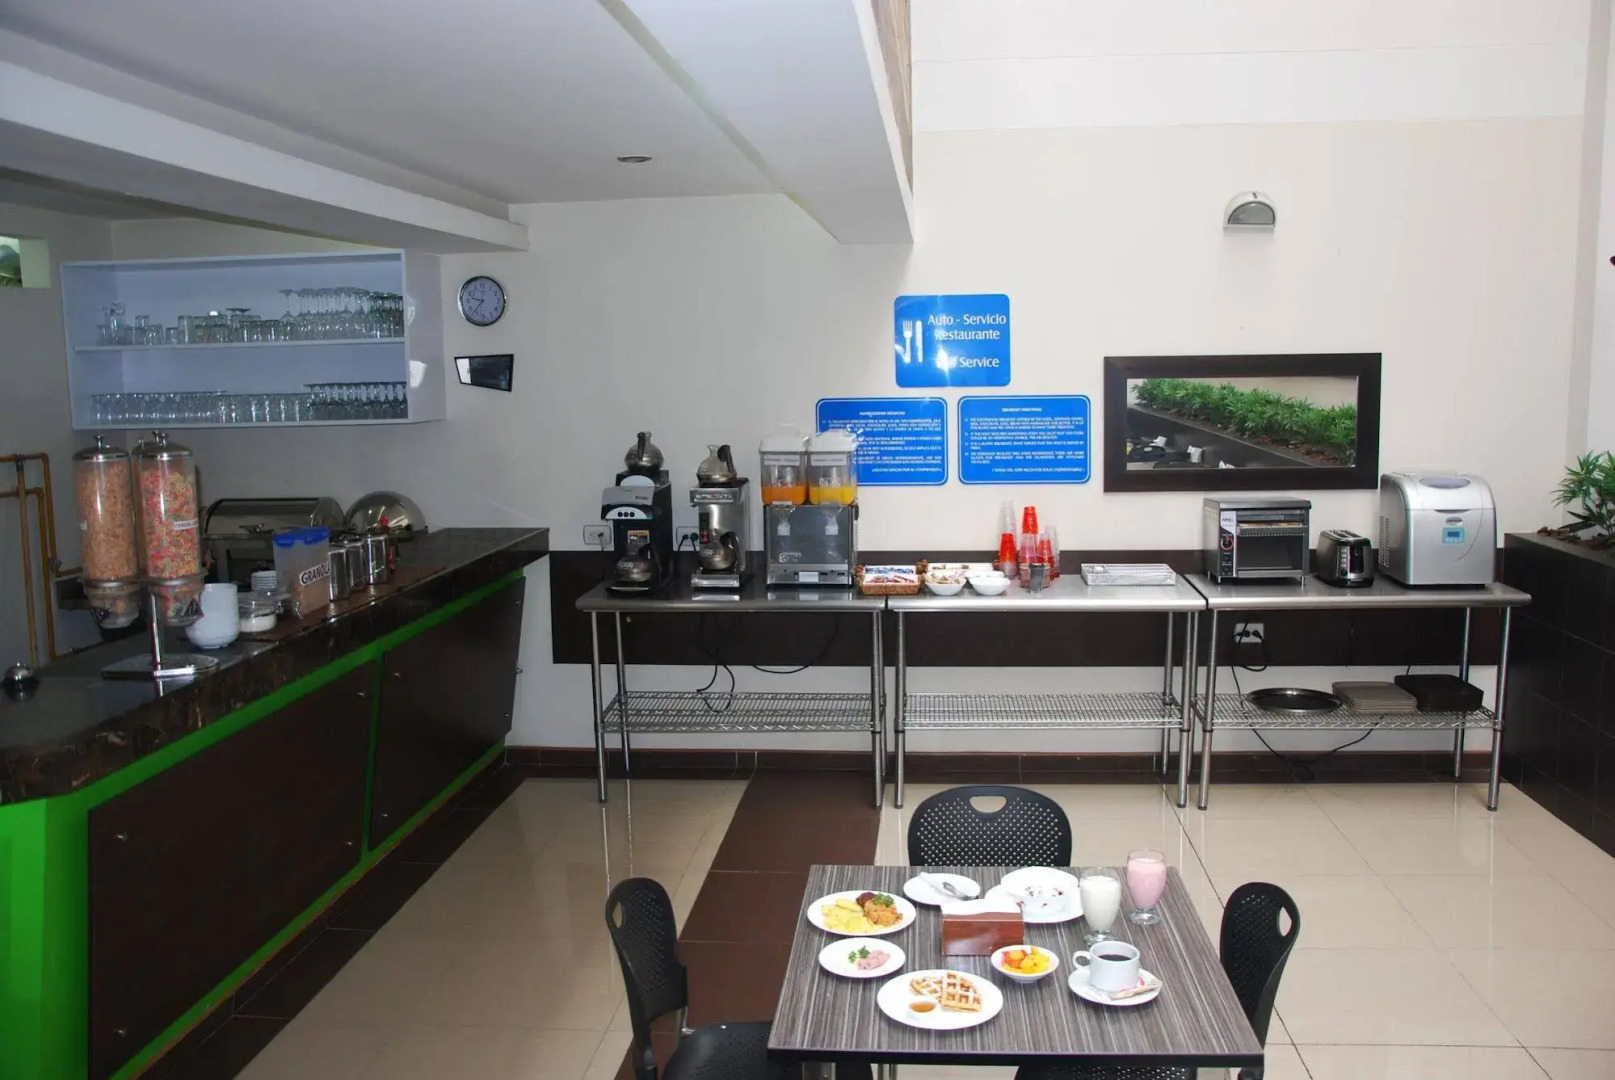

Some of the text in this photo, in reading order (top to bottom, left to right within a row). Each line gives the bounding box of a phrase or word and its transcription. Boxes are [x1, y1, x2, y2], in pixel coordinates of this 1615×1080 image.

[927, 314, 954, 326] Auto
[963, 313, 1007, 325] Servicio
[934, 329, 1000, 341] Restaurante
[959, 356, 1000, 368] Service
